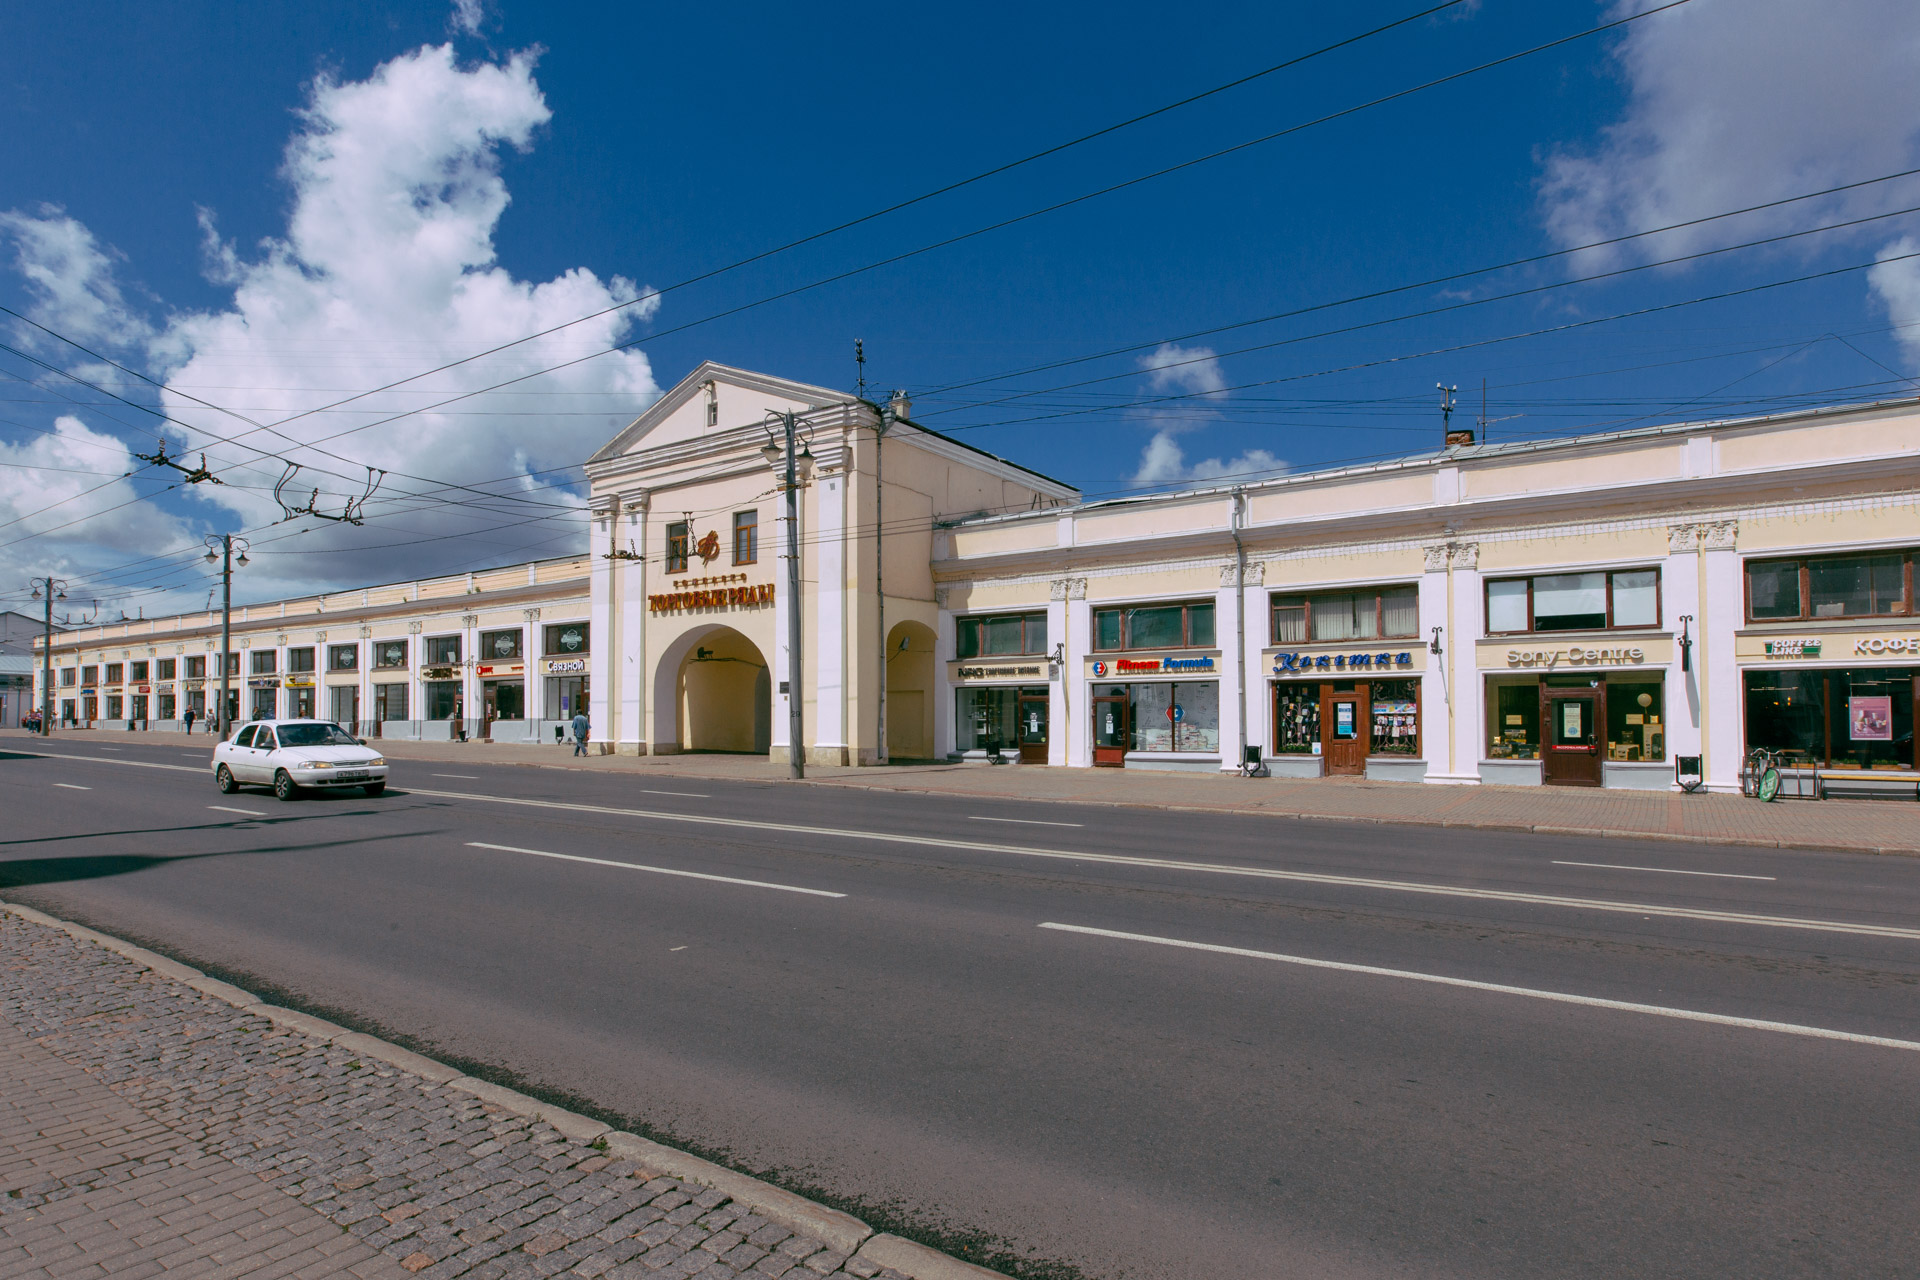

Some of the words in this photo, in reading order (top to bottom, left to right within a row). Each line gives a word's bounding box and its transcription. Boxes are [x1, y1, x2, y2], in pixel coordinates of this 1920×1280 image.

[648, 589, 727, 611] ТОРГОВЫЕ
[728, 583, 775, 607] РЯДЫ
[1774, 638, 1821, 647] COFFEE
[1854, 637, 1919, 651] КОФЕ
[1507, 649, 1558, 665] Sony
[1567, 646, 1643, 660] Centre
[1773, 647, 1802, 655] LIKE
[1116, 659, 1160, 670] Fitness
[1163, 656, 1214, 669] Formula
[1272, 652, 1411, 672] Кокетка
